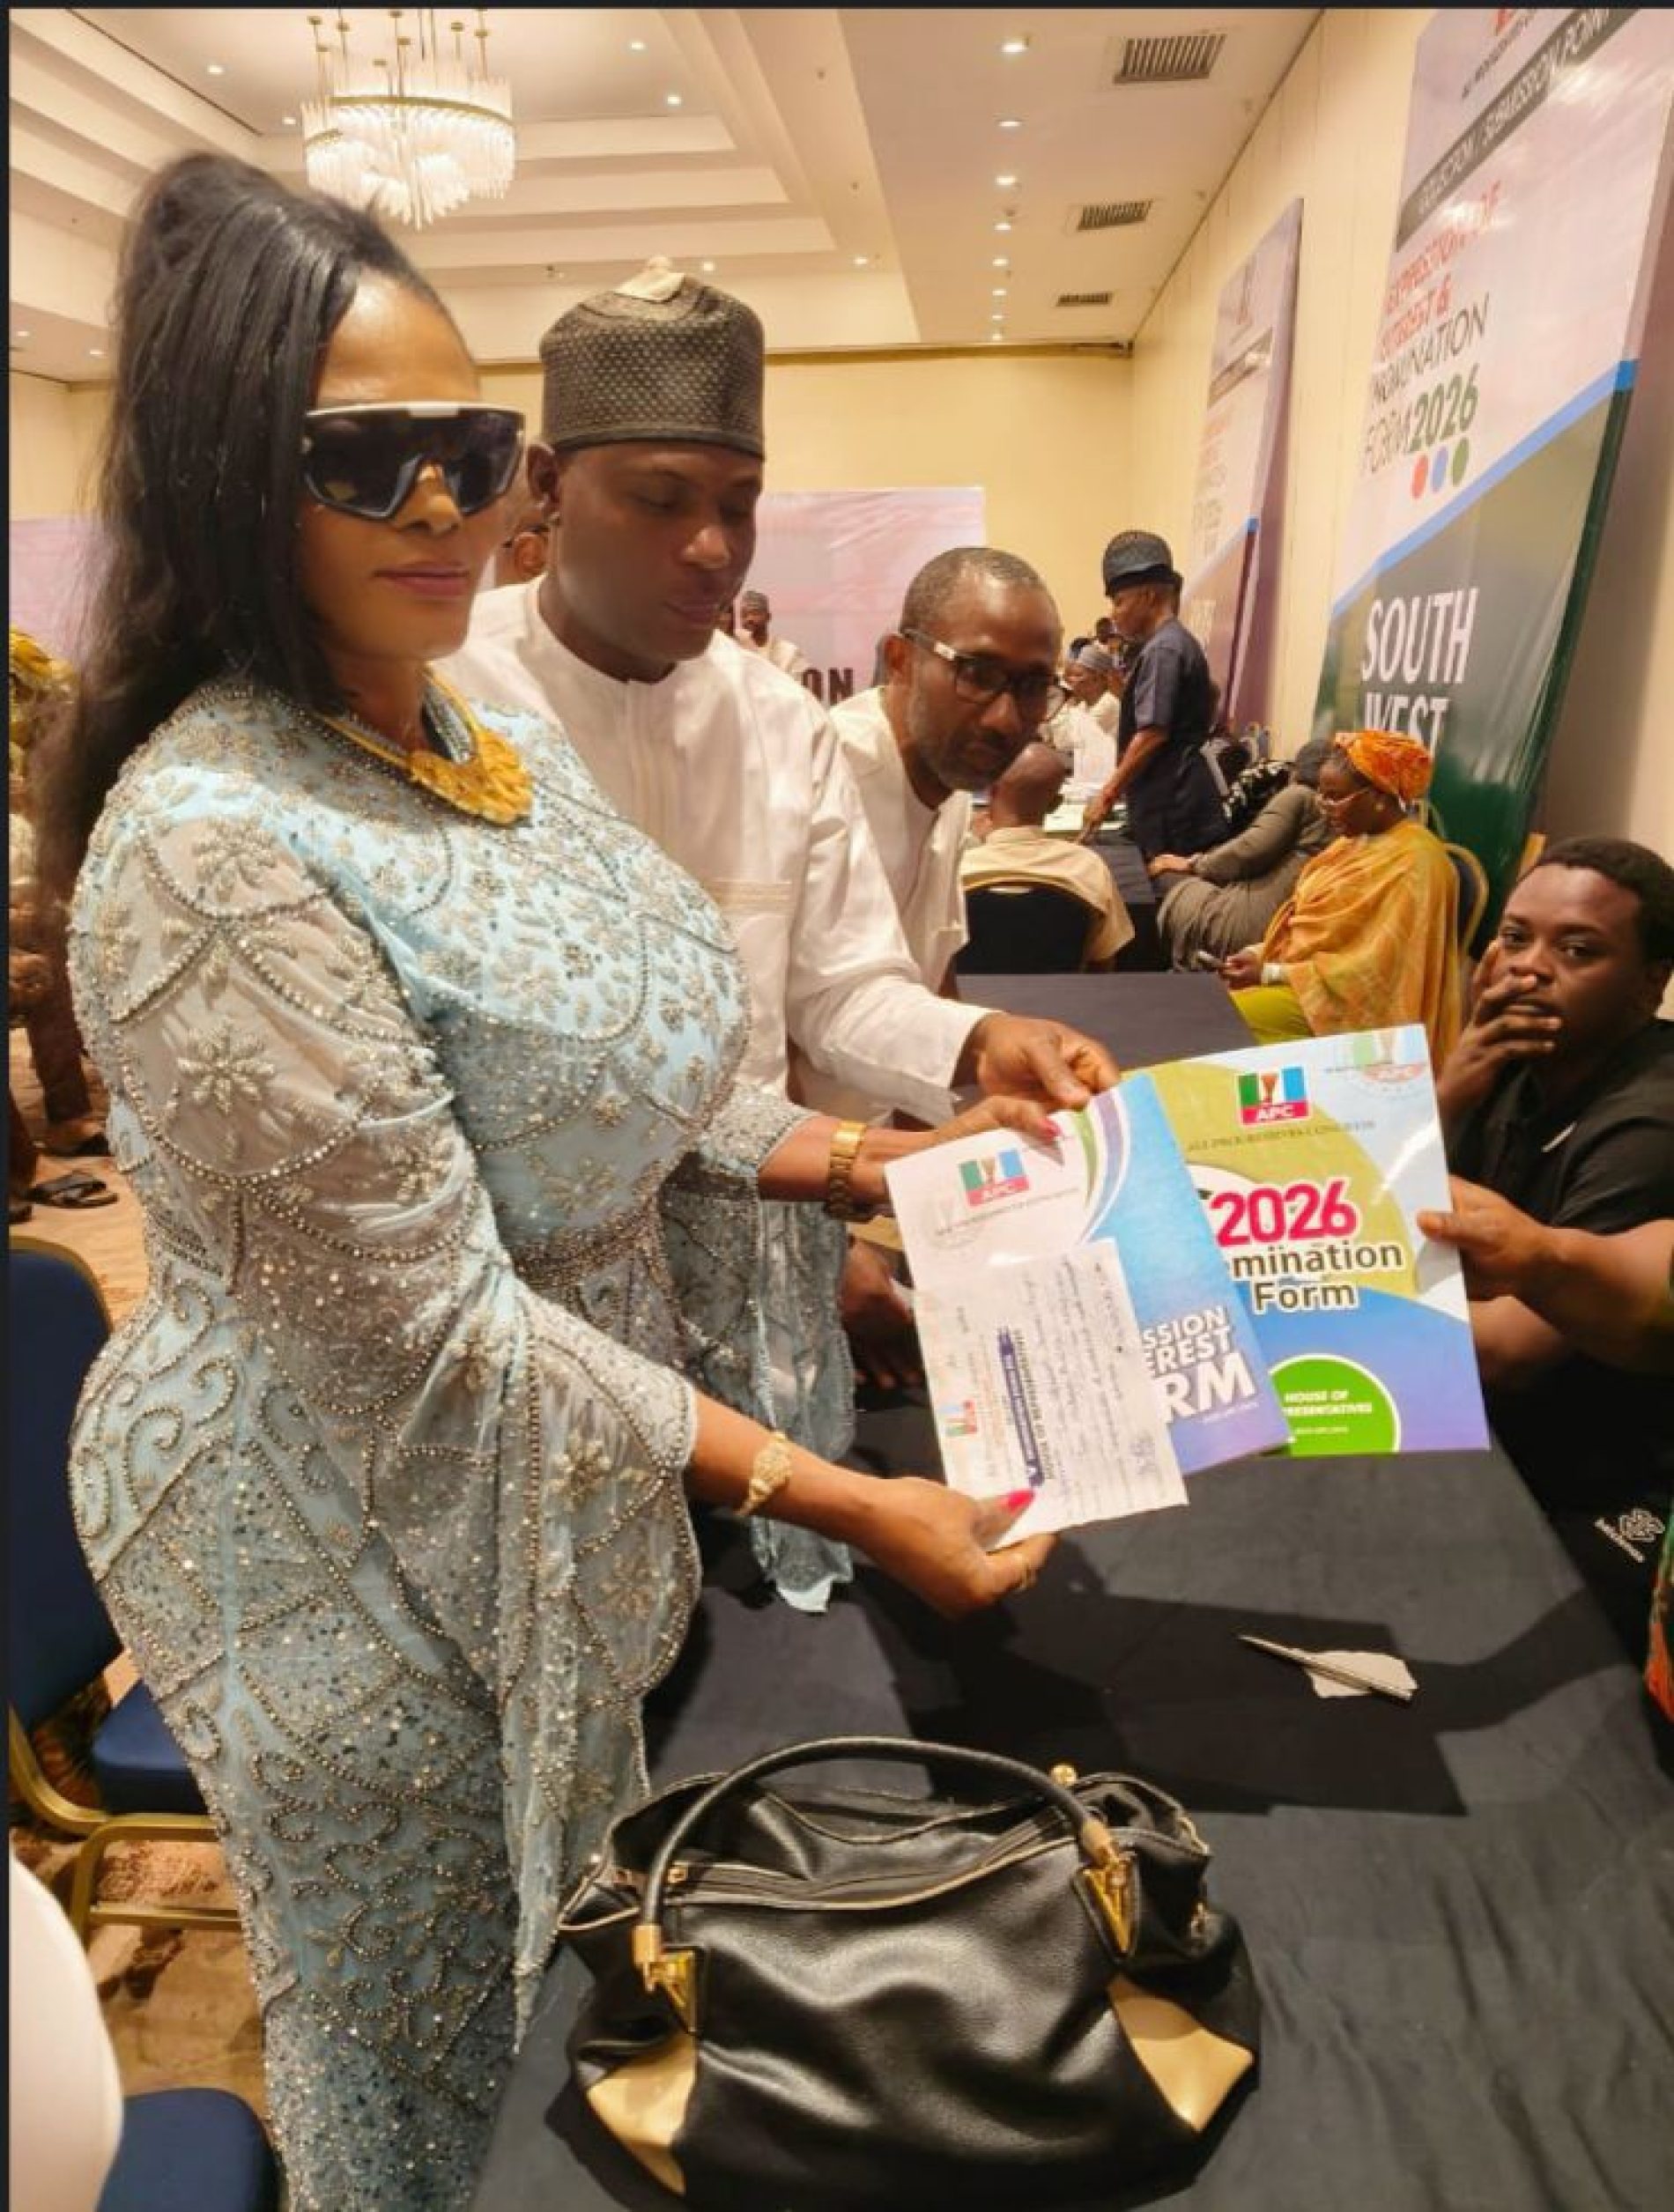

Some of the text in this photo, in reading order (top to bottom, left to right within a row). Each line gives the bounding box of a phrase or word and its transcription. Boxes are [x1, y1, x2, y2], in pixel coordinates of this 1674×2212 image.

[1362, 588, 1479, 684] SOUTH
[1257, 1104, 1294, 1122] APC
[1209, 1180, 1358, 1247] 2026
[1233, 1240, 1403, 1277] mination
[1254, 1283, 1355, 1312] Form
[1142, 1306, 1228, 1349] SSION
[1143, 1326, 1231, 1374] EREST
[1154, 1352, 1256, 1424] RM
